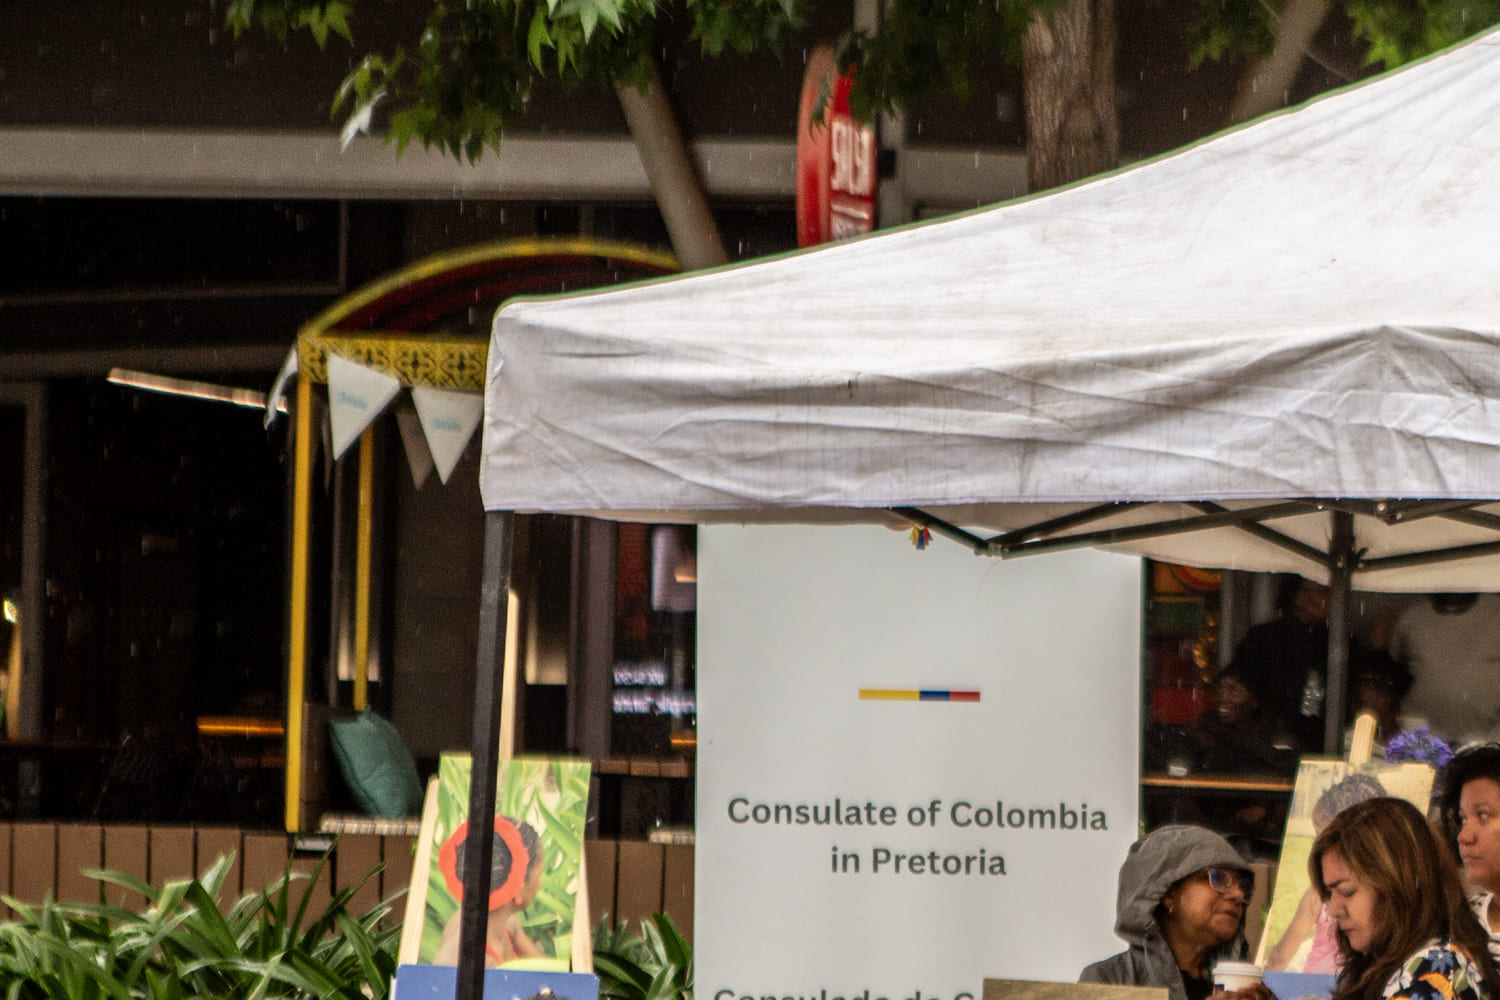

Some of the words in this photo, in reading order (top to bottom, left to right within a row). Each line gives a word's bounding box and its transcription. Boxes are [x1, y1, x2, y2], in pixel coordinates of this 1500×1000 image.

[727, 797, 897, 826] Consulate
[906, 799, 942, 828] of
[950, 800, 1109, 831] Colombia
[831, 845, 860, 874] in
[872, 847, 1007, 876] Pretoria
